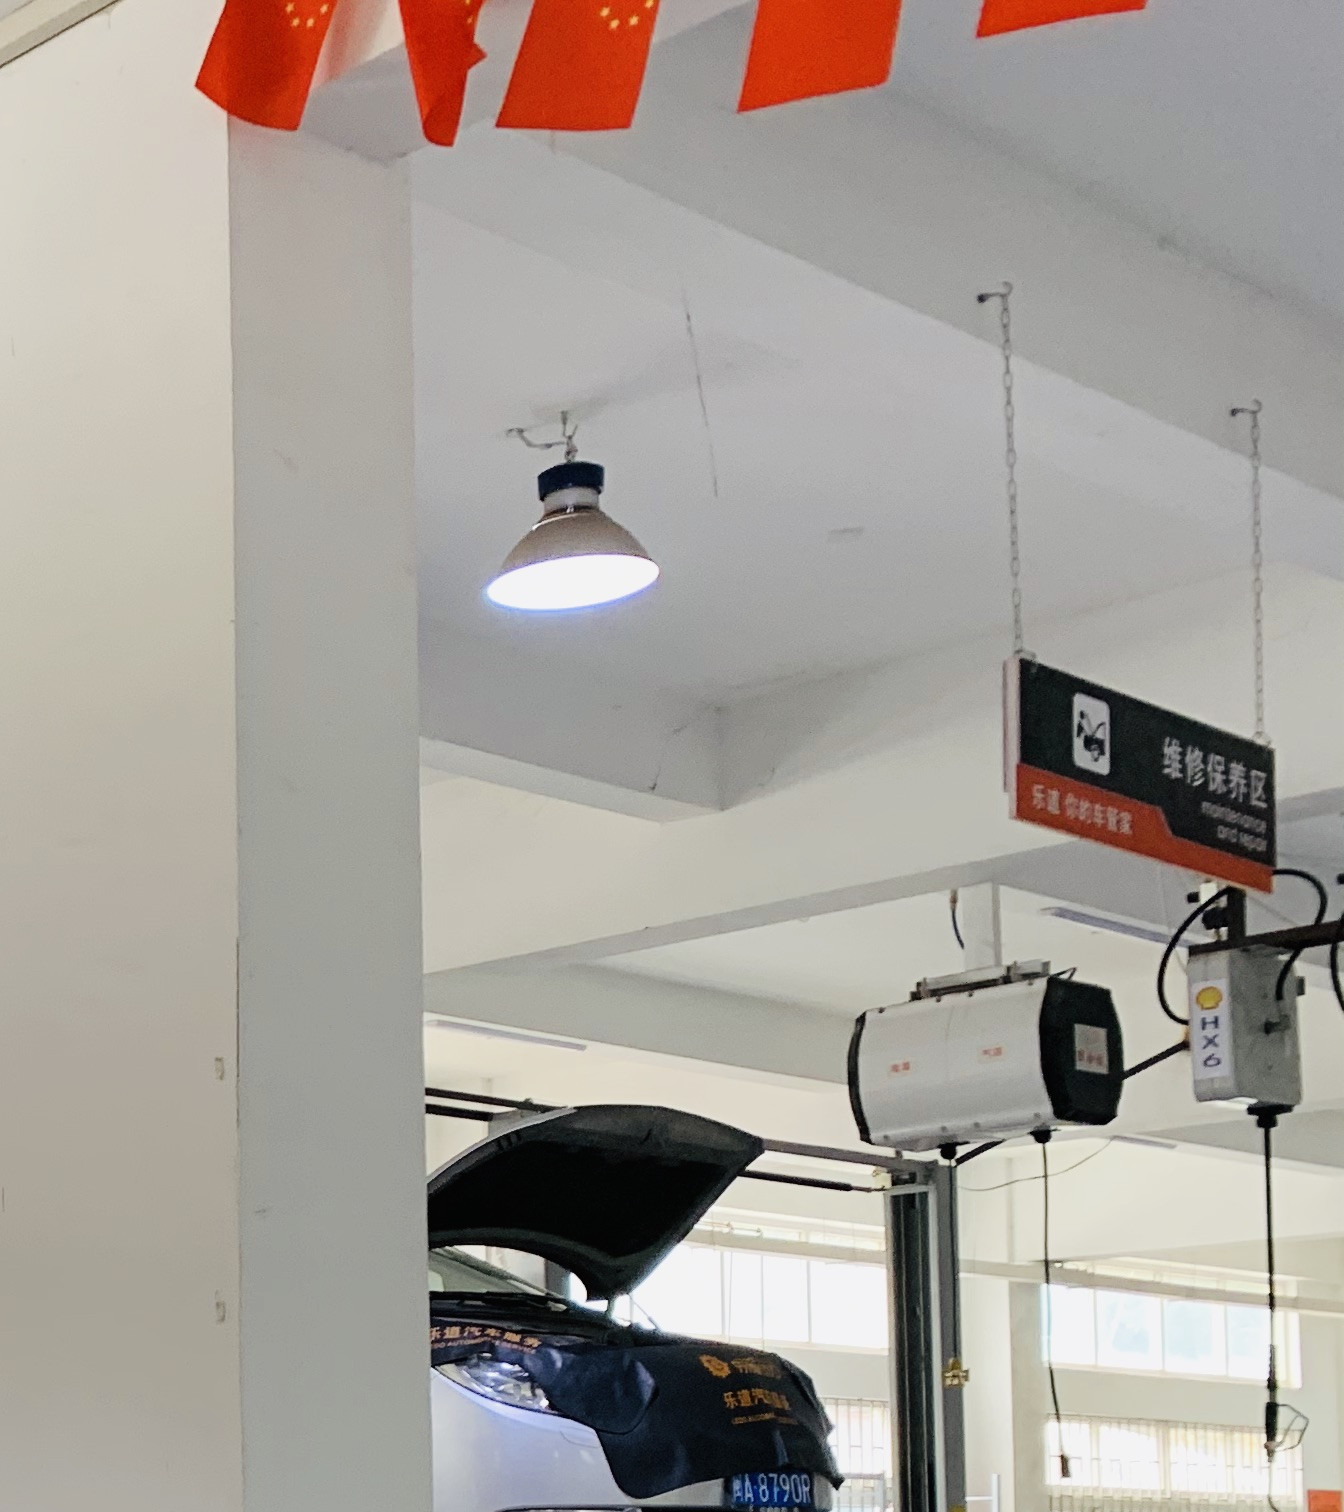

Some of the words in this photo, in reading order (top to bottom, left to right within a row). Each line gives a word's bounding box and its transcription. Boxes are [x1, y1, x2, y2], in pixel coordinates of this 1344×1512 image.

[1162, 736, 1268, 809] 维修保养区
